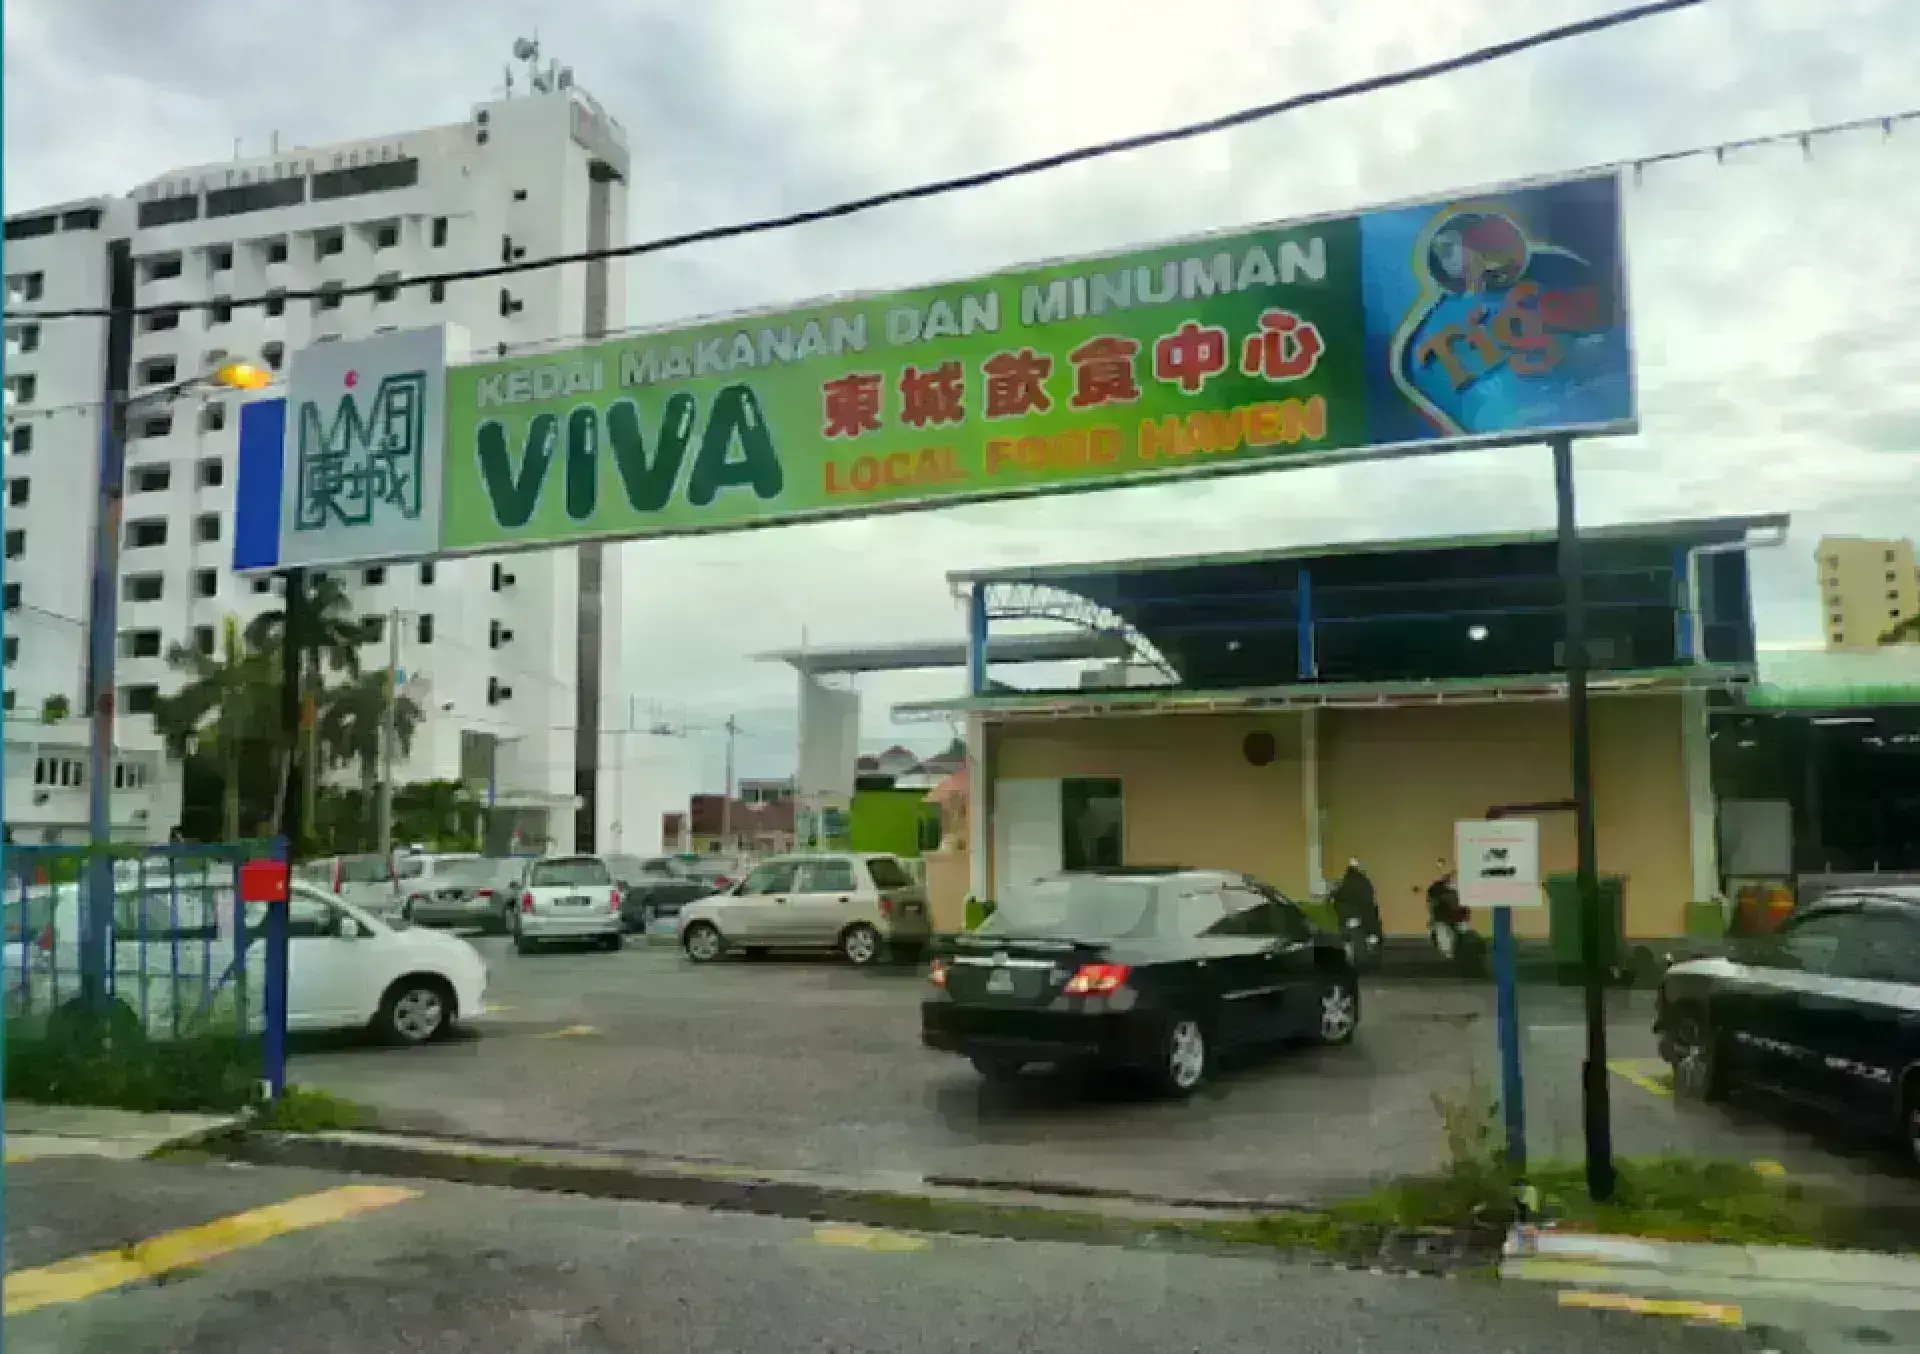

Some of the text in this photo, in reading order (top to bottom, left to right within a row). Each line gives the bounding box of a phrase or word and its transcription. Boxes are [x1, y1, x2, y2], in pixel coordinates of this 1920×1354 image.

[476, 236, 1327, 408] KEDAI MAKANAN DAN MINUMAN
[821, 307, 1325, 438] 東城飲食中心
[475, 381, 784, 528] VIVA
[824, 394, 1328, 495] LOCAL FOOD HAVEN
